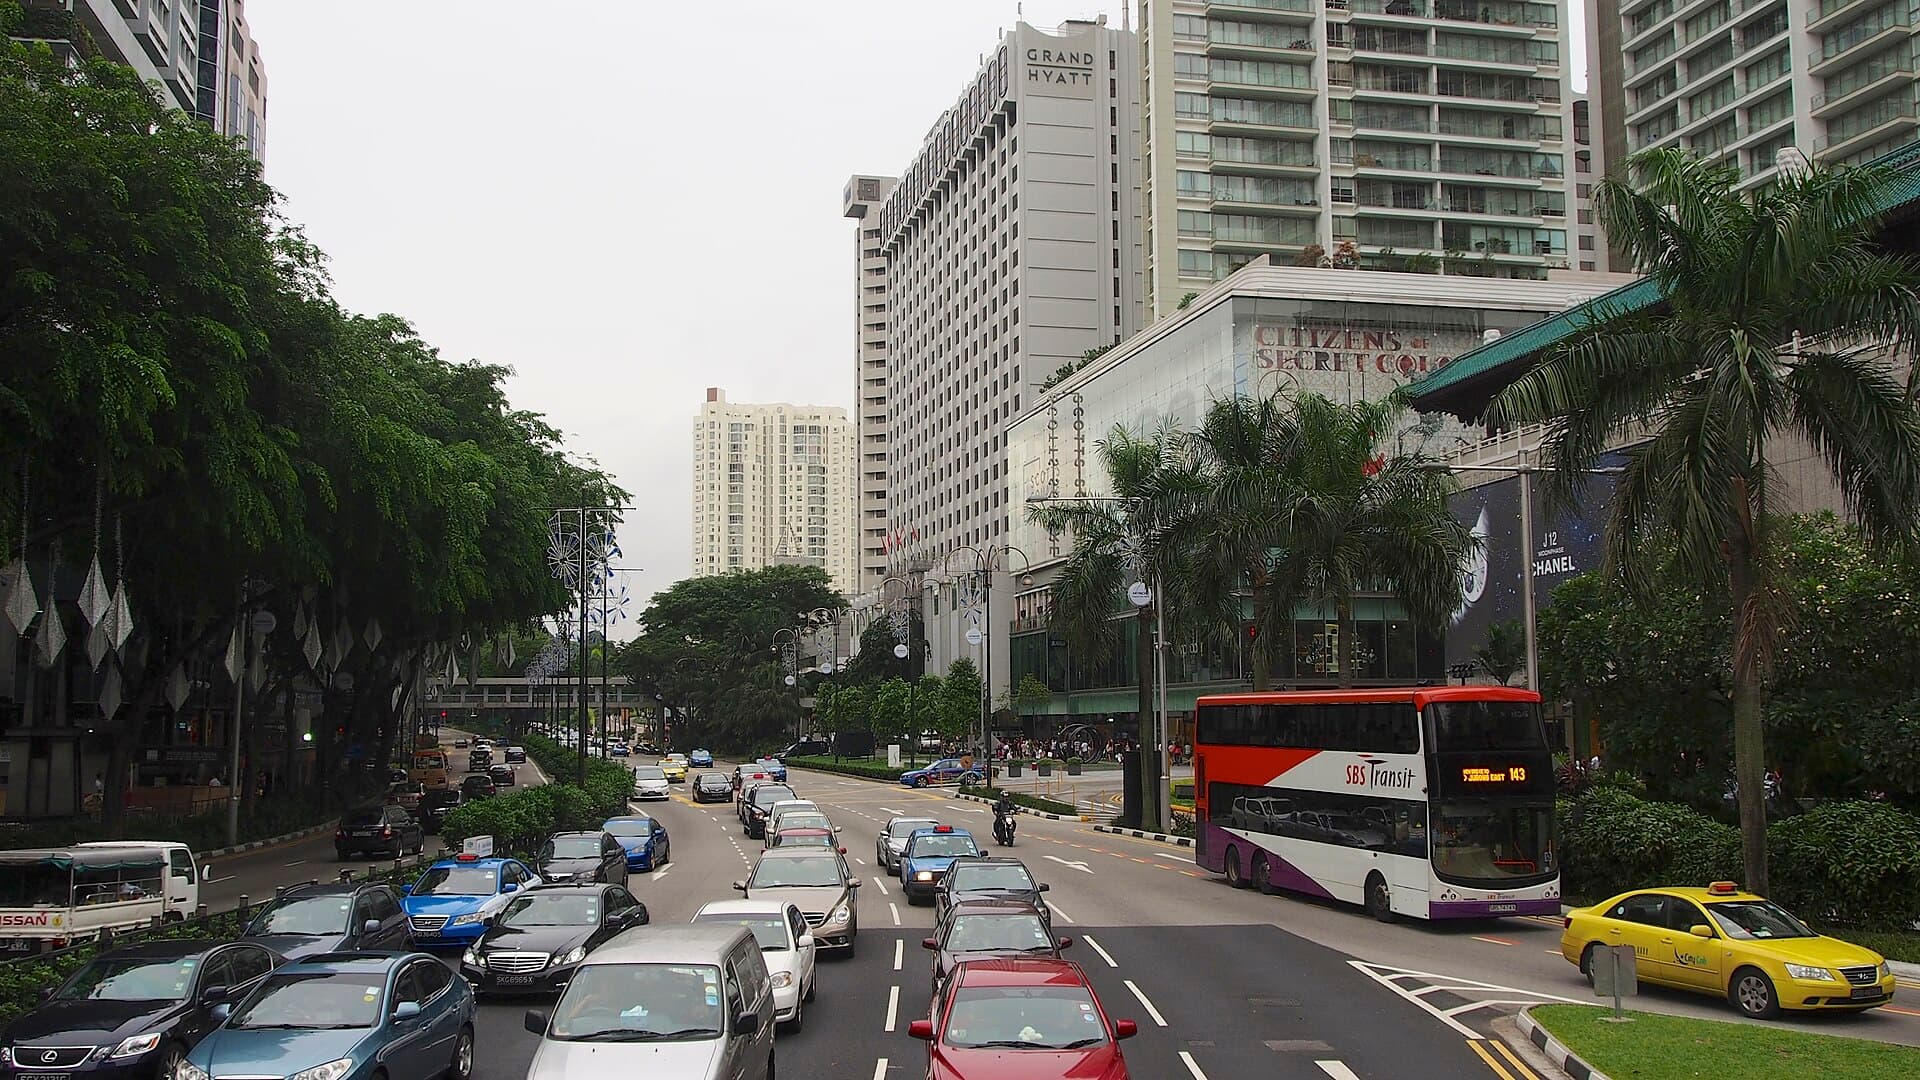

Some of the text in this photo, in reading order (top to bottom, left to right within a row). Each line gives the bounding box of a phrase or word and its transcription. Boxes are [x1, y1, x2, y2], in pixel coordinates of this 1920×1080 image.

[1026, 48, 1094, 65] GRAND
[1028, 69, 1093, 86] HYATT
[1254, 326, 1402, 352] CITIZENS
[1256, 348, 1370, 373] SECRET
[1346, 759, 1417, 791] SBS Transit
[1509, 767, 1526, 781] 143
